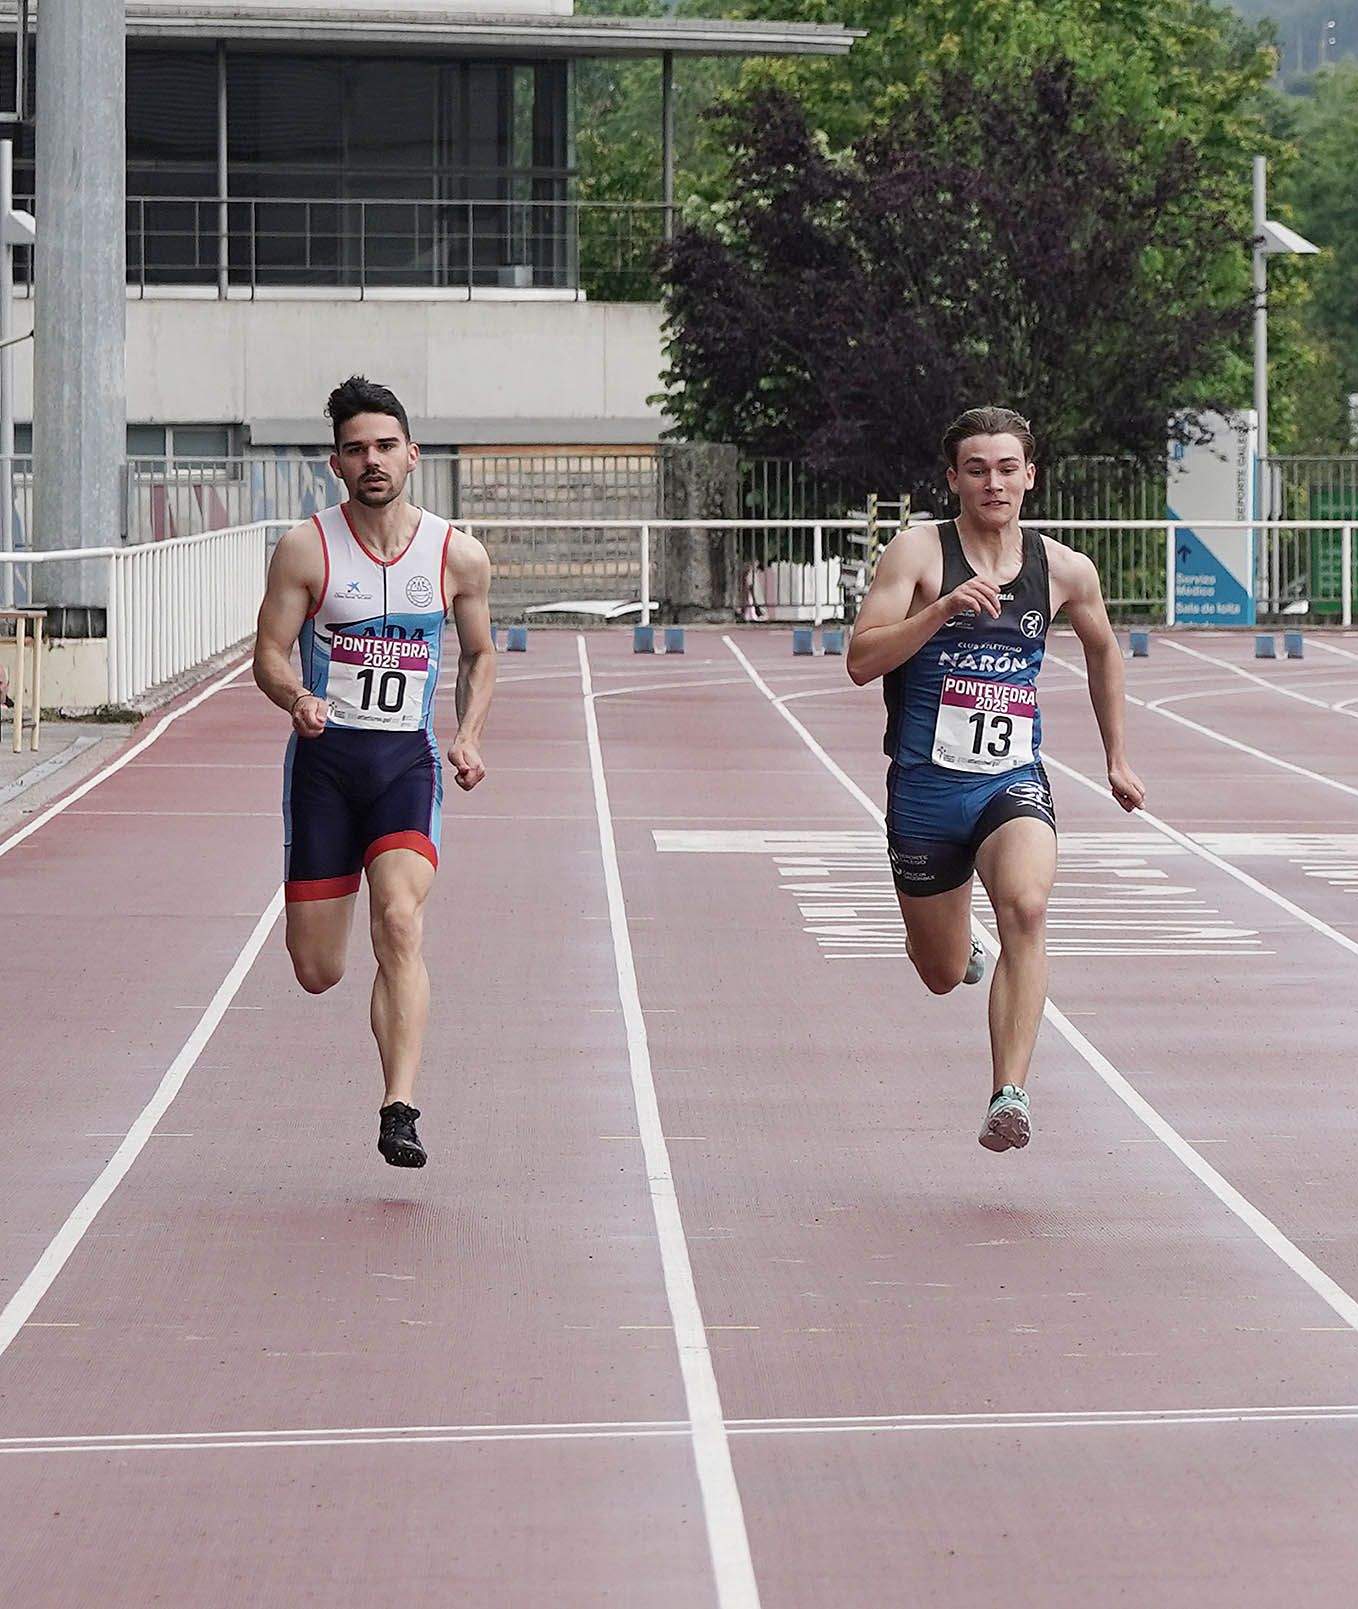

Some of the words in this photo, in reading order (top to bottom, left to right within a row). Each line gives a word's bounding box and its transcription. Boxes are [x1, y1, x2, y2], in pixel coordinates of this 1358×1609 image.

[333, 634, 429, 659] PONTEVEDRA
[363, 653, 400, 668] 2025
[938, 650, 1028, 673] NARÓN
[356, 668, 407, 713] 10
[945, 678, 1036, 706] PONTEVEDRA
[975, 696, 1009, 713] 2025
[969, 712, 1013, 757] 13
